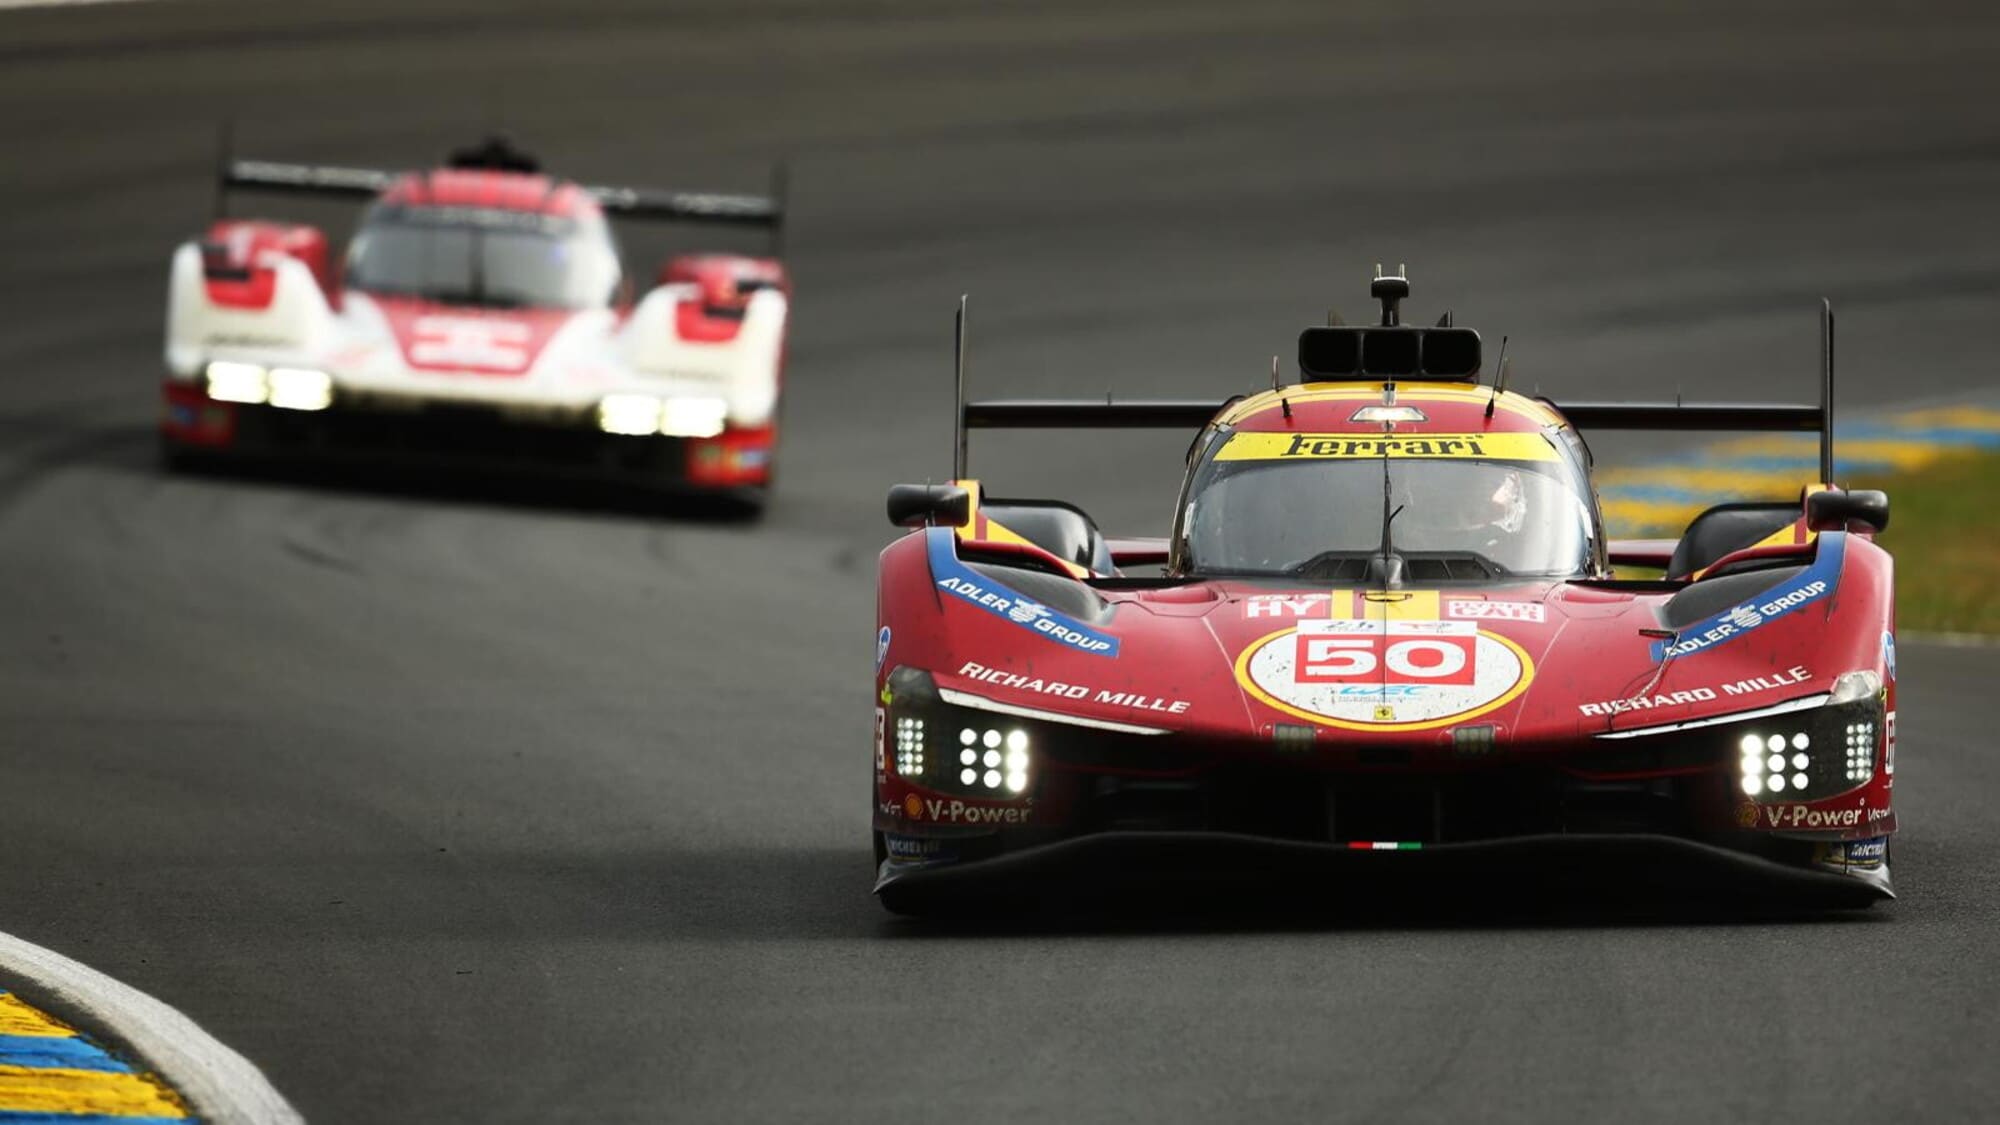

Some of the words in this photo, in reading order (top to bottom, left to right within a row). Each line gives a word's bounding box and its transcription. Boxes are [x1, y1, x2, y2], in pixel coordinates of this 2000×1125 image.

[1280, 434, 1486, 456] Ferrari
[937, 577, 1012, 612] ADLER
[1033, 619, 1111, 652] GROUP
[1664, 624, 1741, 656] ADLER
[1759, 581, 1827, 616] GROUP
[1305, 639, 1466, 678] 50
[958, 661, 1089, 700] RICHARD
[1094, 689, 1192, 714] MILLE
[1340, 685, 1430, 696] WEC
[1578, 687, 1717, 717] RICHARD
[1720, 666, 1813, 696] MILLE
[926, 799, 1031, 823] V-Power
[1767, 805, 1862, 827] V-Power
